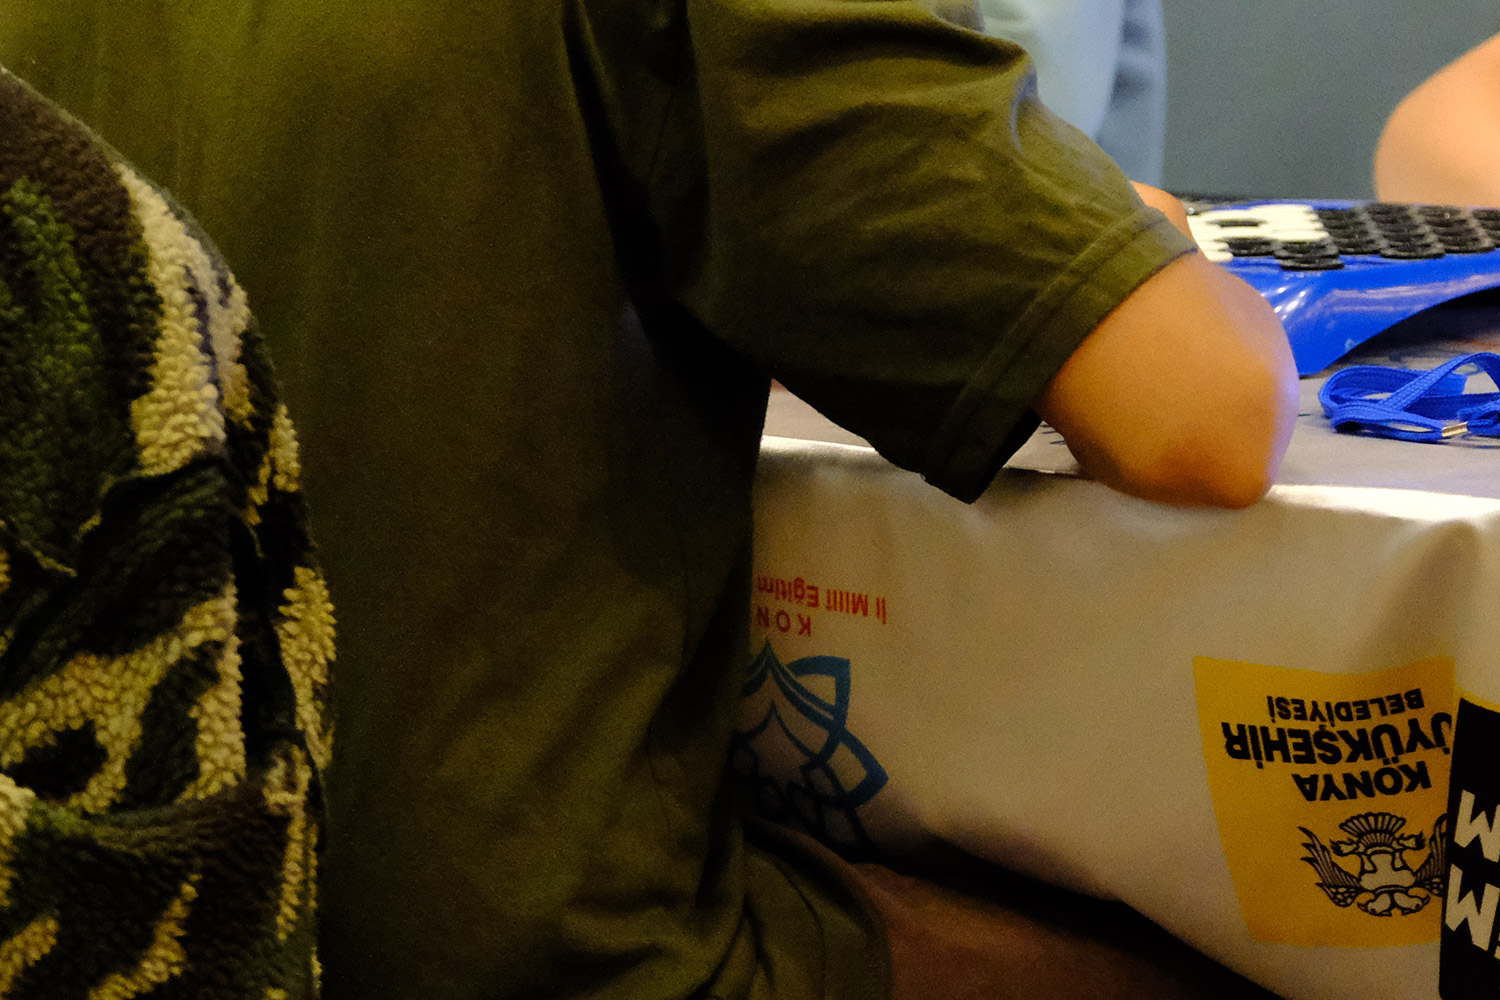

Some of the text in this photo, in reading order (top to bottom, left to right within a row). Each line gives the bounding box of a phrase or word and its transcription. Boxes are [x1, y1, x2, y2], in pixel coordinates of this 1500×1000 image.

[757, 605, 812, 637] KON
[1266, 688, 1426, 728] BELEDİYESİ
[1220, 711, 1453, 770] ÜYÜKŞEHİR
[1291, 760, 1432, 803] KONYA
